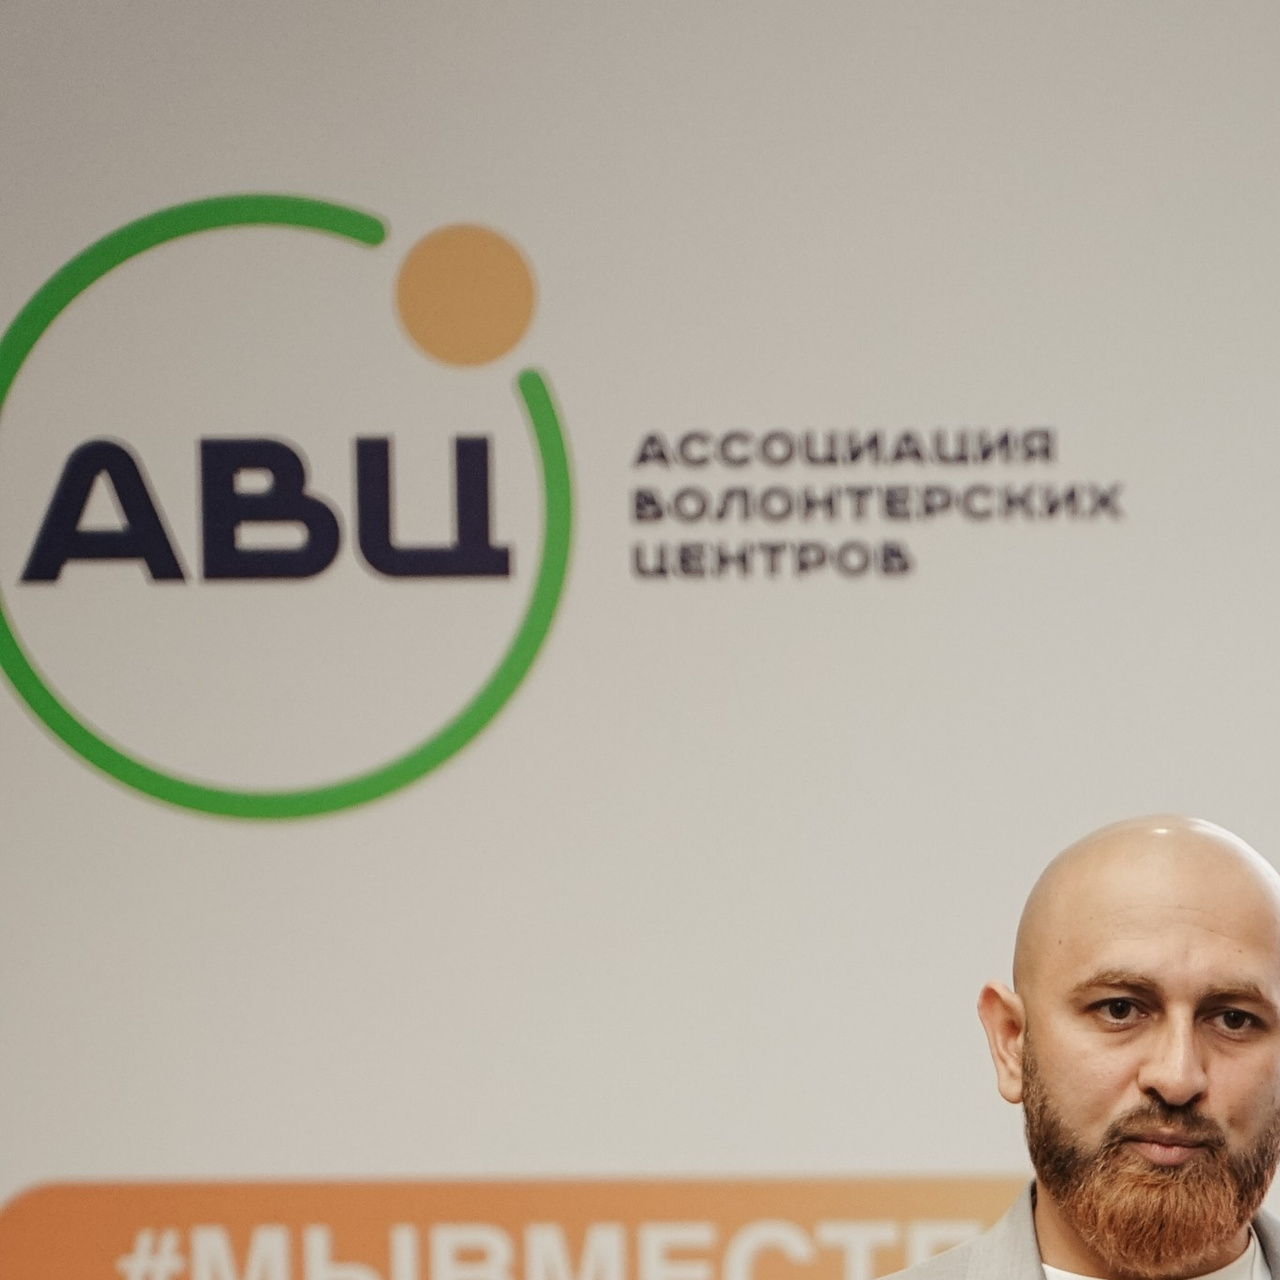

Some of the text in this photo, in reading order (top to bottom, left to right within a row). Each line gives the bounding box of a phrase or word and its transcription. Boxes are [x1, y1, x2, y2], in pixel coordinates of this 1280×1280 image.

[633, 428, 1057, 469] АССОЦИАЦИЯ
[19, 435, 513, 587] АВЦ
[631, 484, 1123, 524] ВОЛОНТЕРСКИХ
[631, 541, 914, 580] ЦЕНТРОВ
